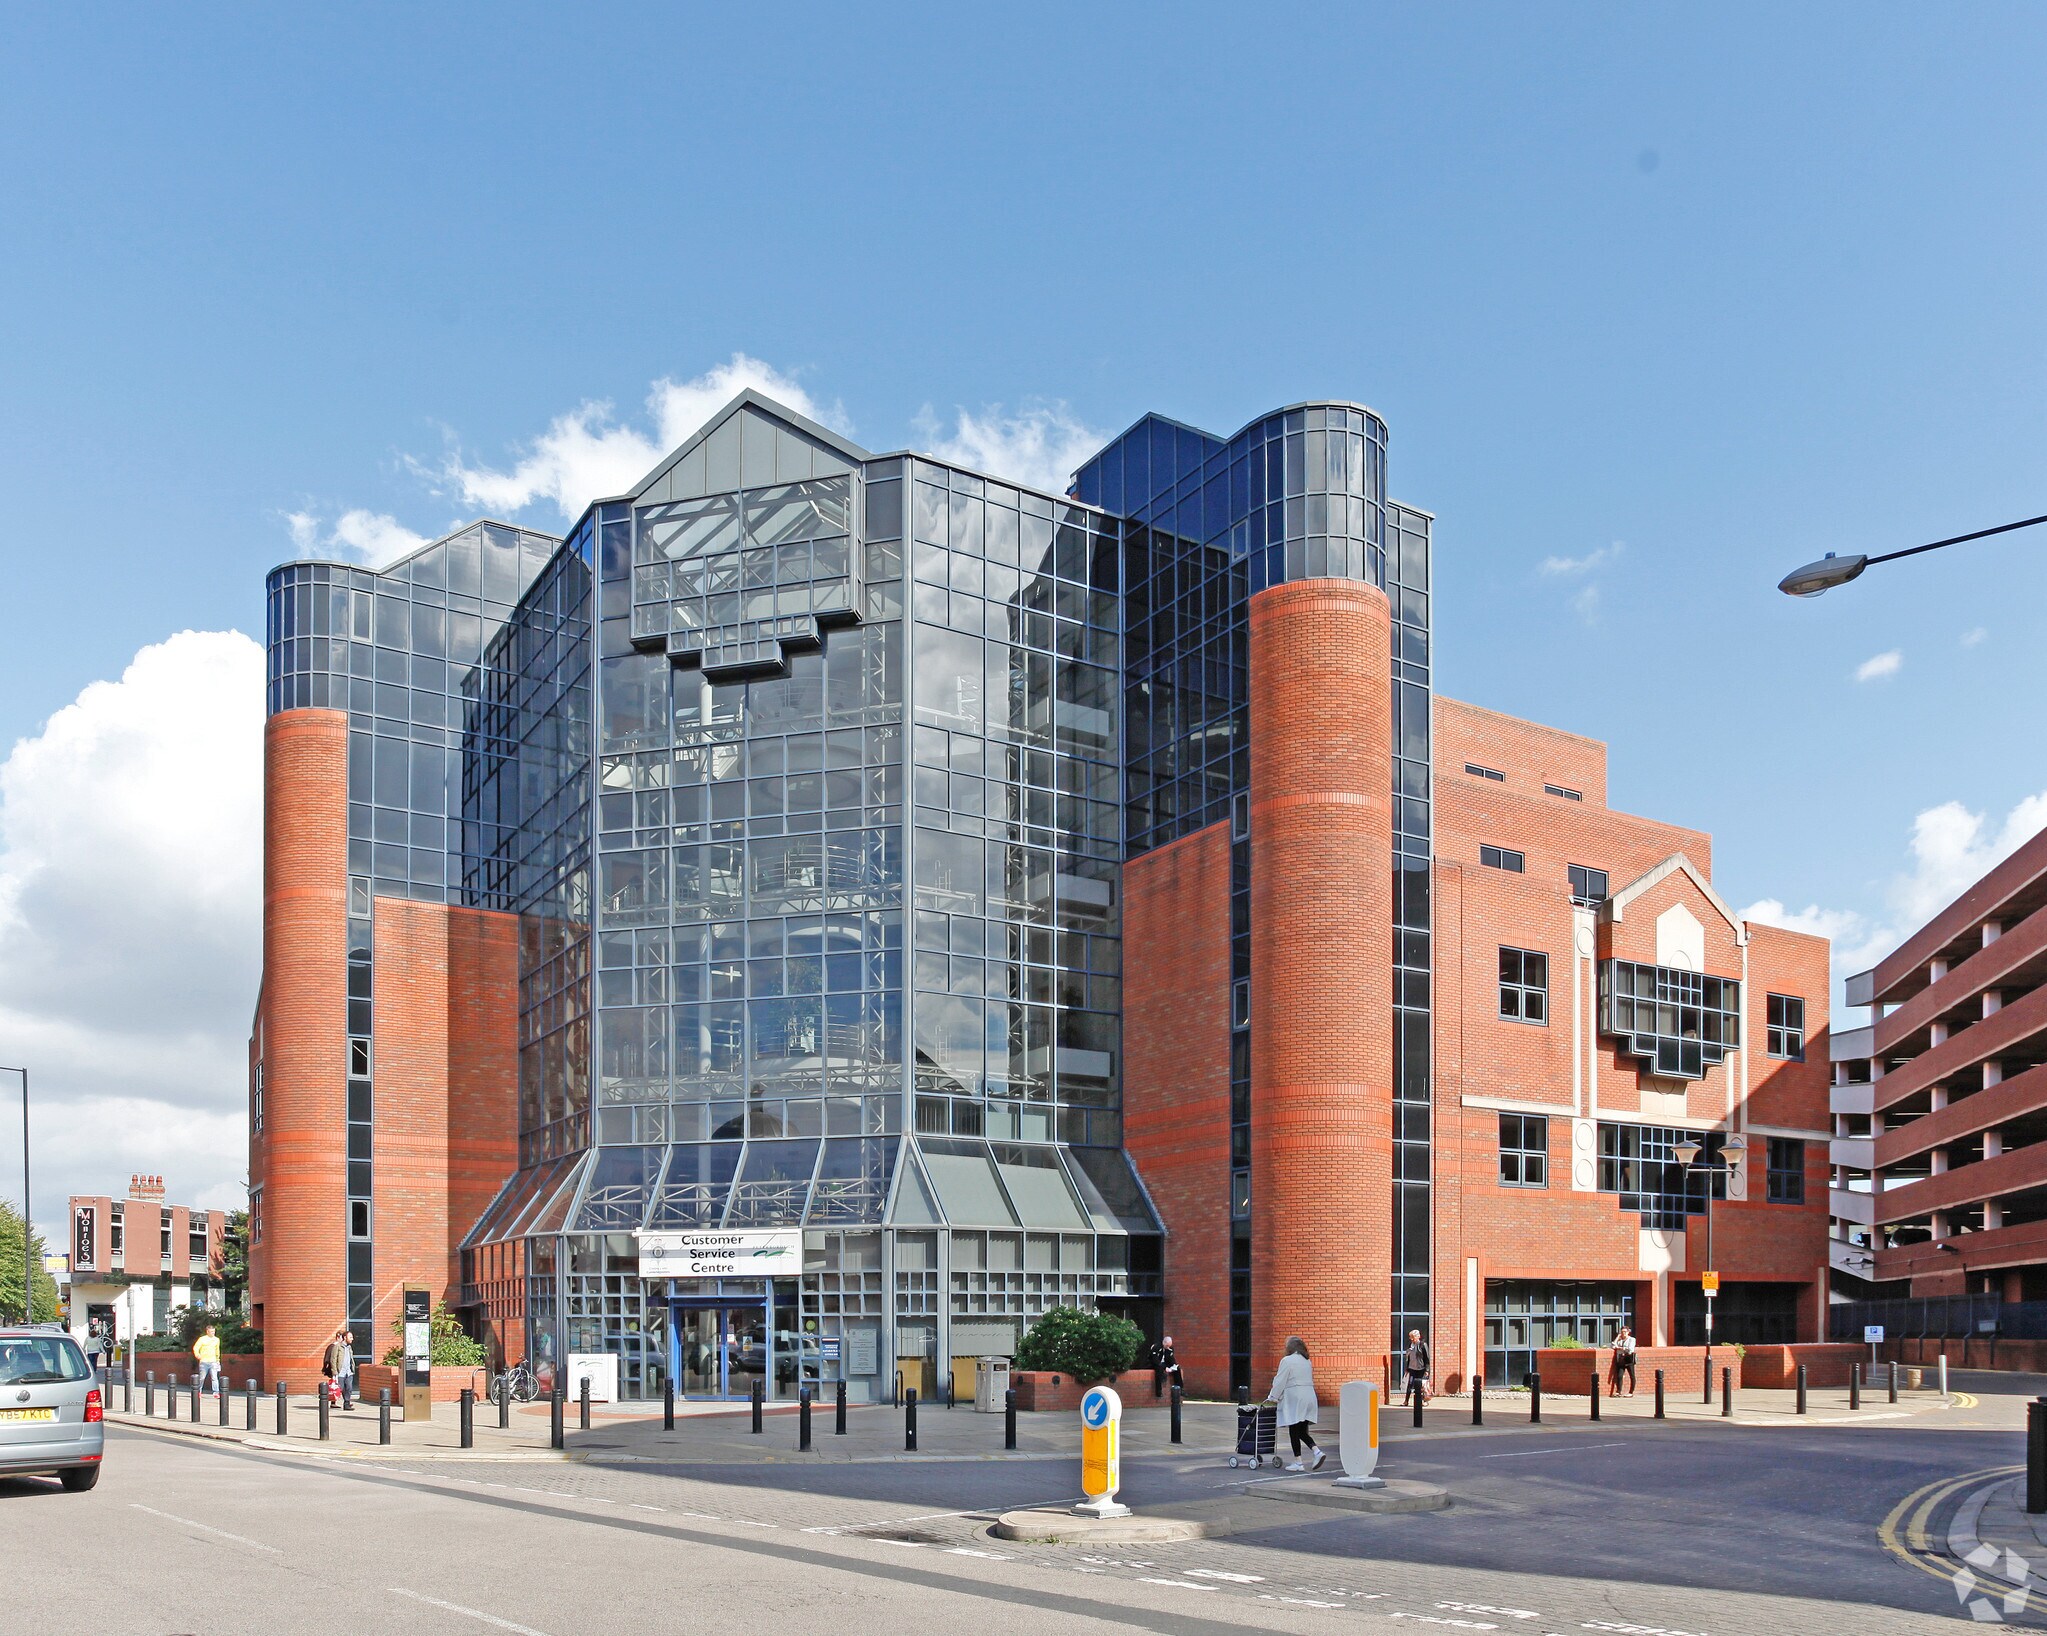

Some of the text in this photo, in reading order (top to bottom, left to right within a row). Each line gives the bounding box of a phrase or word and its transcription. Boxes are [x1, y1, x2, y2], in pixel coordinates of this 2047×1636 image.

[81, 1210, 90, 1261] Monroes
[681, 1235, 744, 1245] Customer
[689, 1248, 736, 1259] Service
[691, 1262, 734, 1272] Centre
[0, 1409, 51, 1420] YB57 KTC
